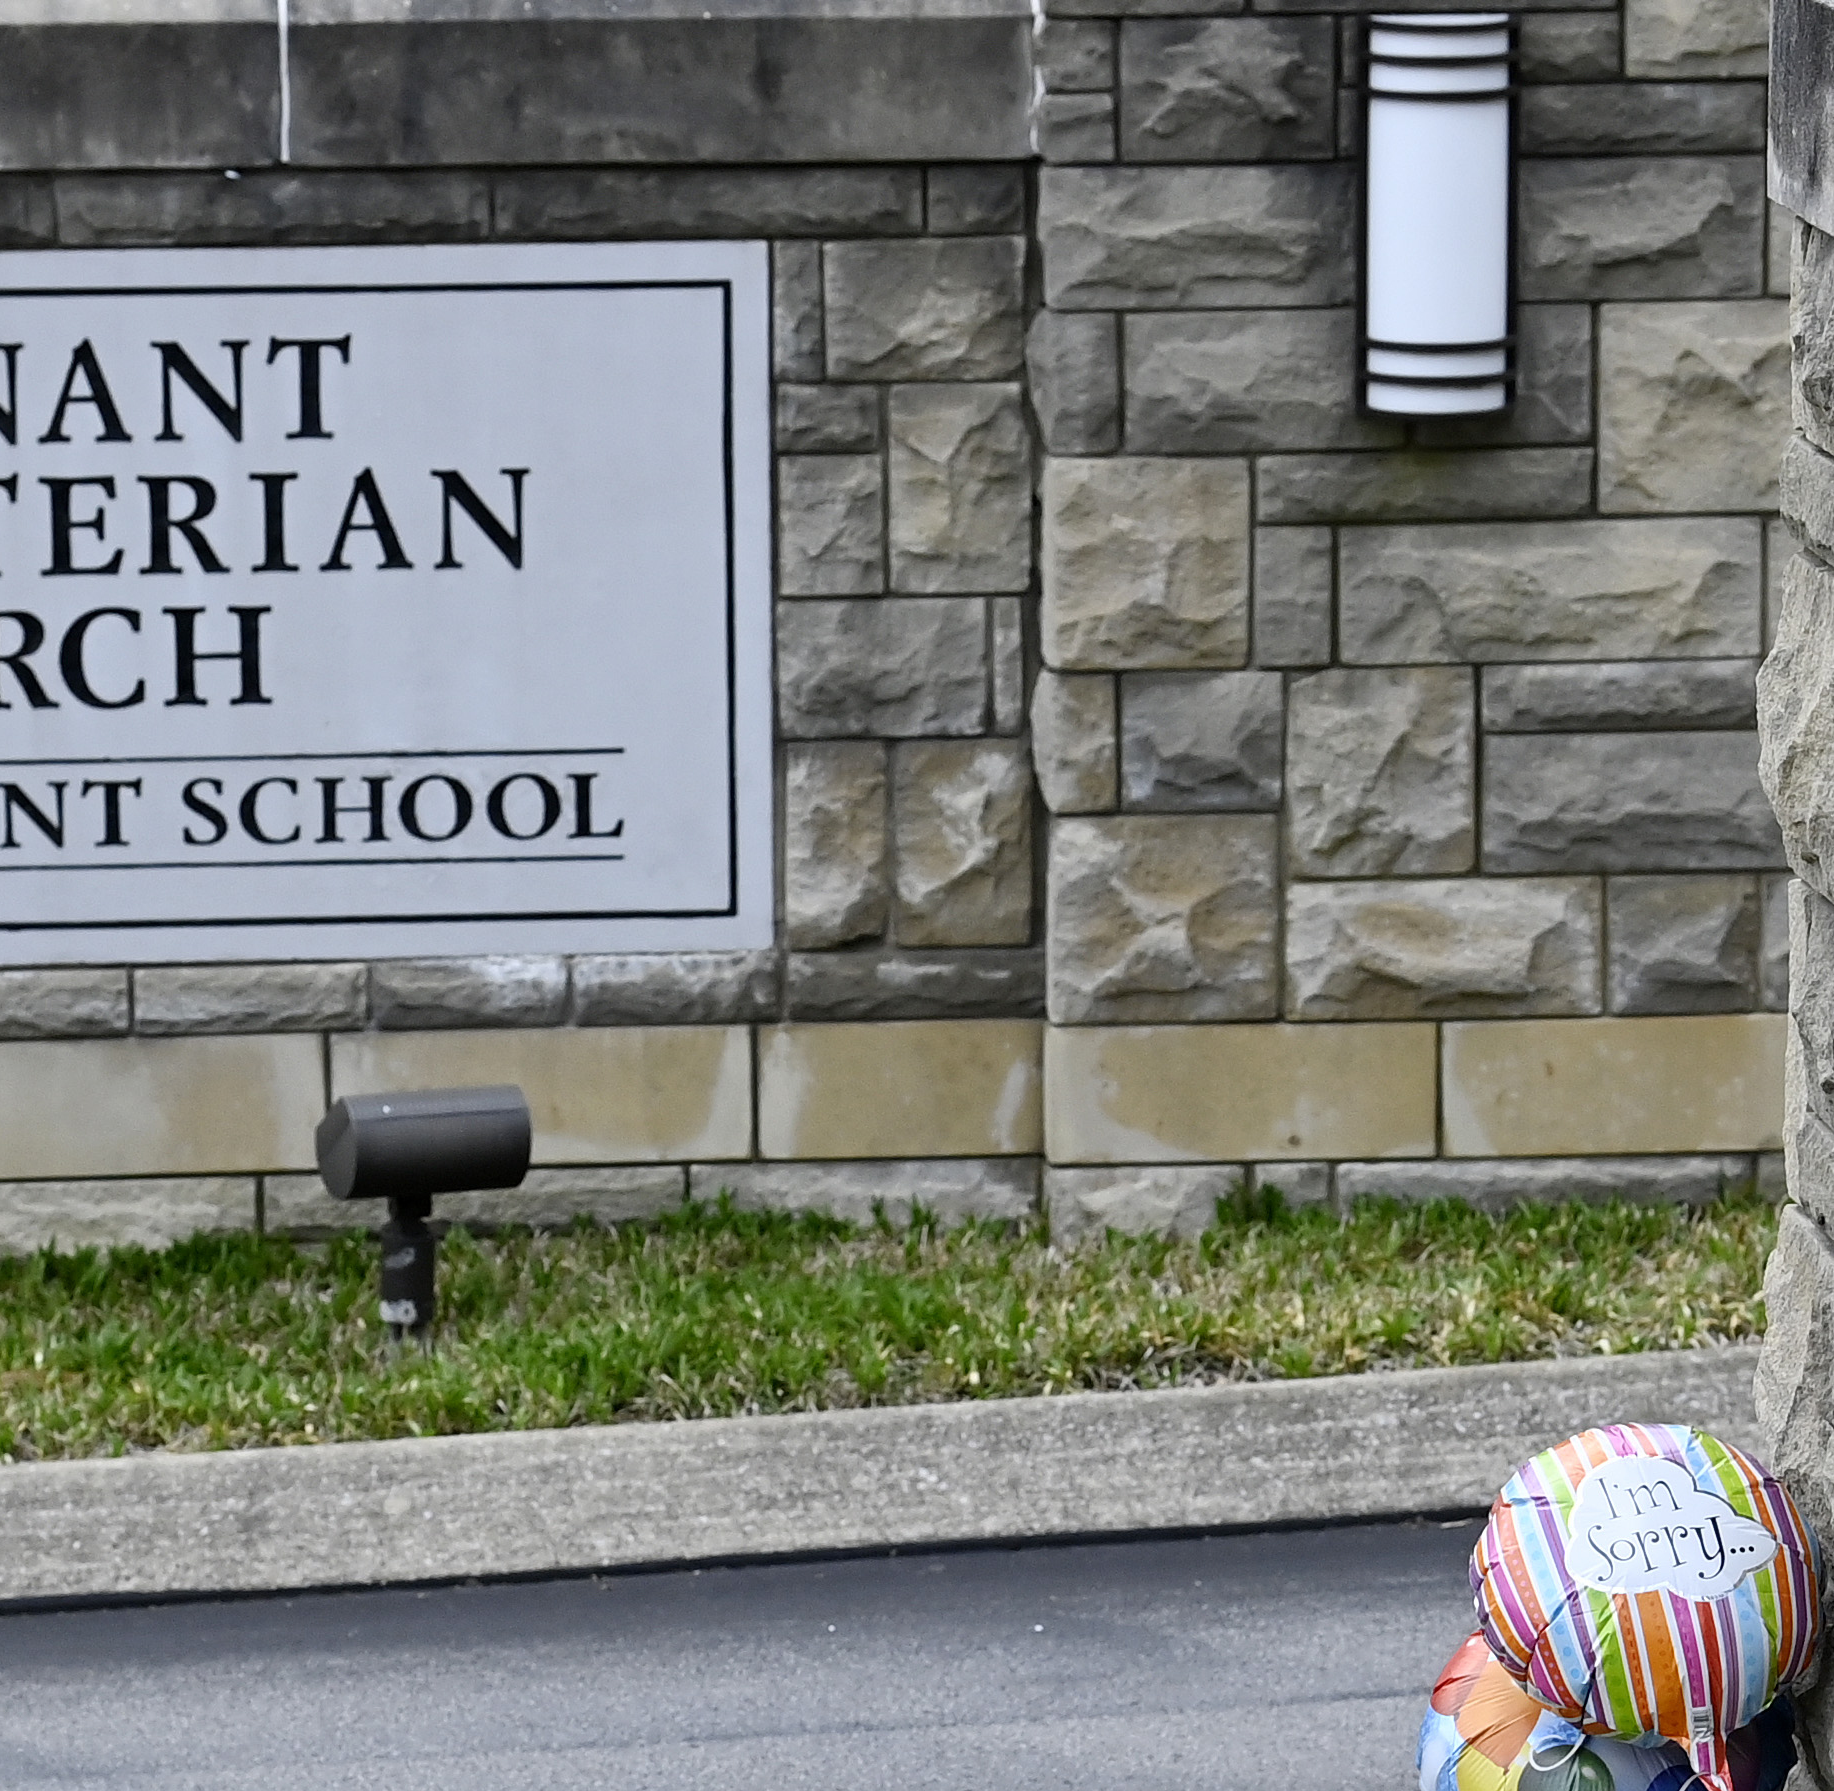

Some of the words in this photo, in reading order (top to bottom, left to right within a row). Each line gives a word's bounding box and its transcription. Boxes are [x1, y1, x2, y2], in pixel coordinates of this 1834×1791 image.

[182, 772, 624, 846] SCHOOL
[1595, 1476, 1683, 1521] I'm
[1587, 1515, 1755, 1581] Sorry...
